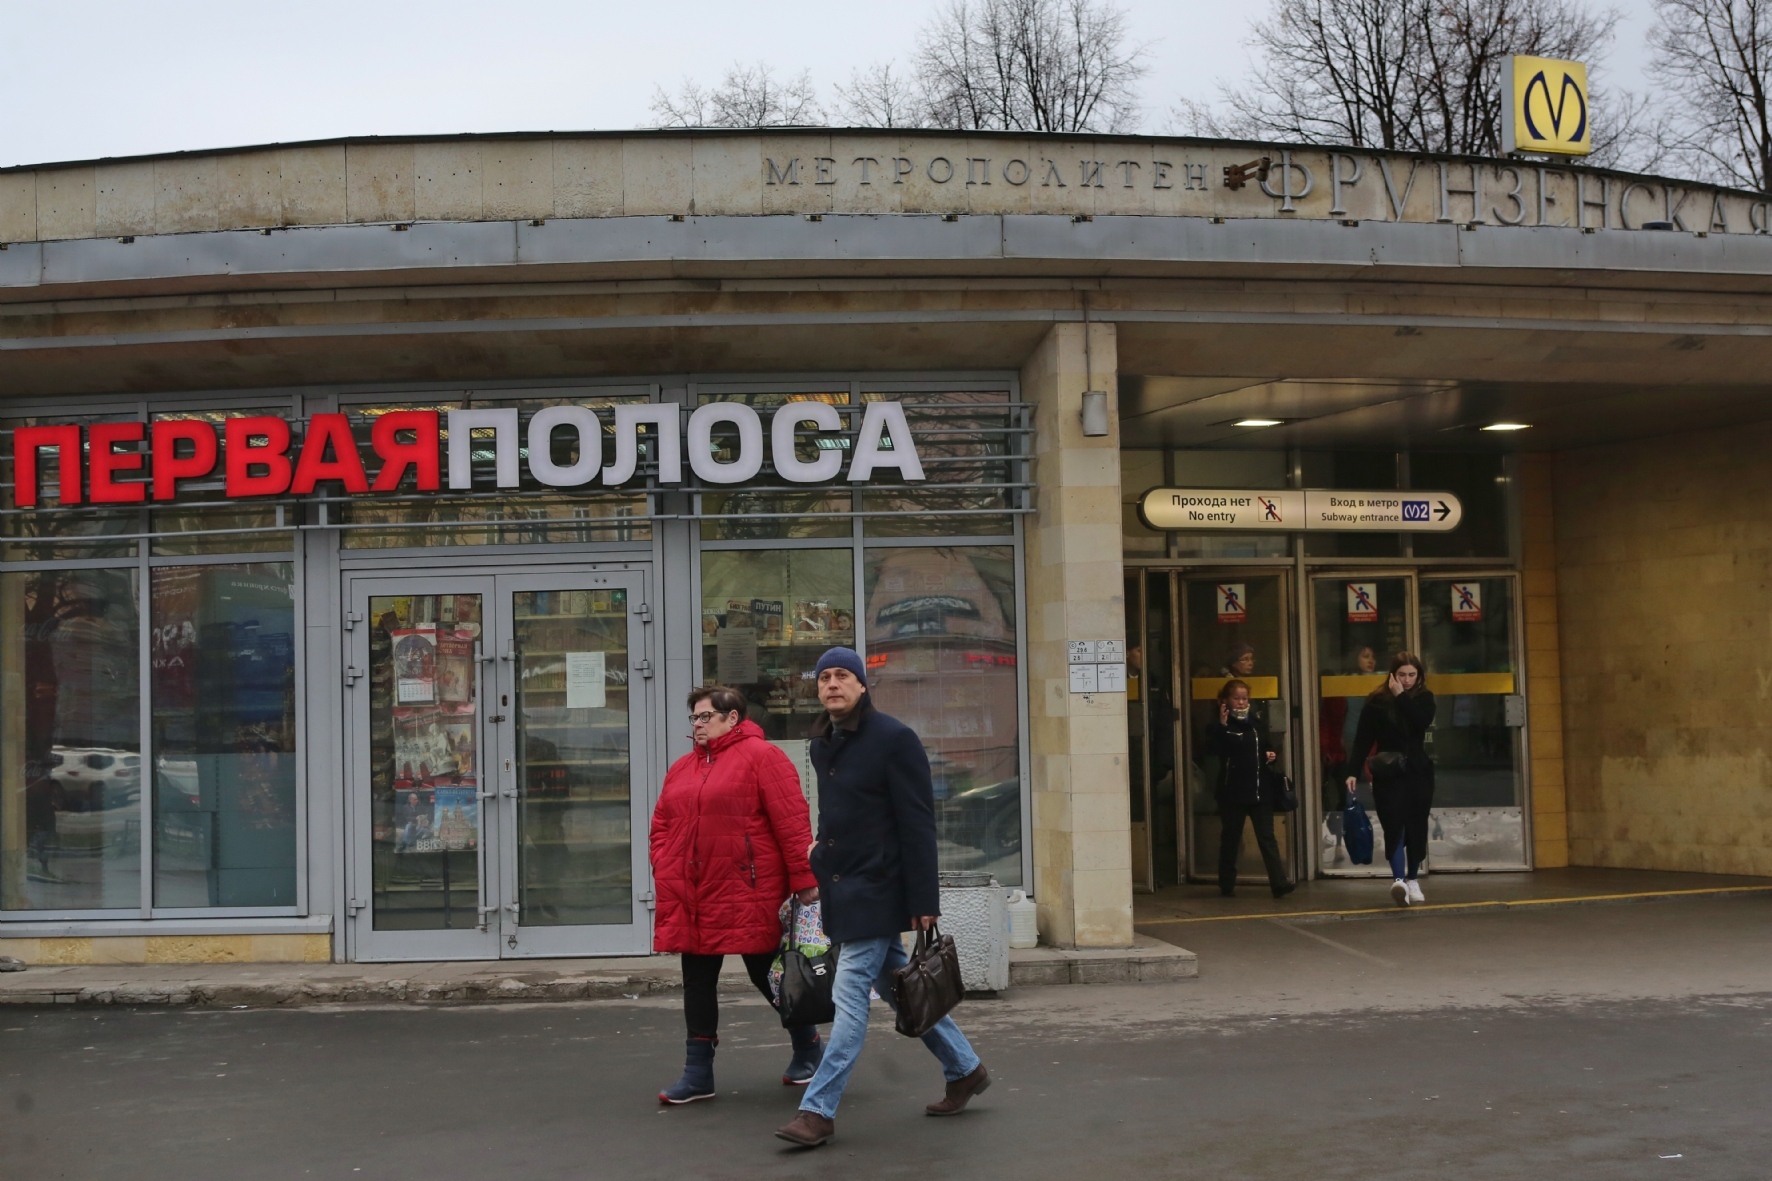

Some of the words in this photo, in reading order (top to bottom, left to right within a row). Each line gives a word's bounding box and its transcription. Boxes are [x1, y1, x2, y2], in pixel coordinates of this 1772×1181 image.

[765, 156, 1209, 191] МЕТРОПОЛИТЕН
[14, 410, 441, 506] ПЕРВАЯ
[448, 401, 926, 490] ПОЛОСА
[1171, 495, 1228, 508] Прохода
[1229, 497, 1251, 507] нет
[1330, 497, 1357, 509] Вход
[1358, 499, 1365, 507] в
[1366, 499, 1399, 509] метро
[1189, 511, 1204, 521] No
[1206, 511, 1236, 524] entry
[1321, 512, 1358, 524] Subway
[1359, 513, 1399, 522] entrance
[755, 602, 782, 612] ПУТИН
